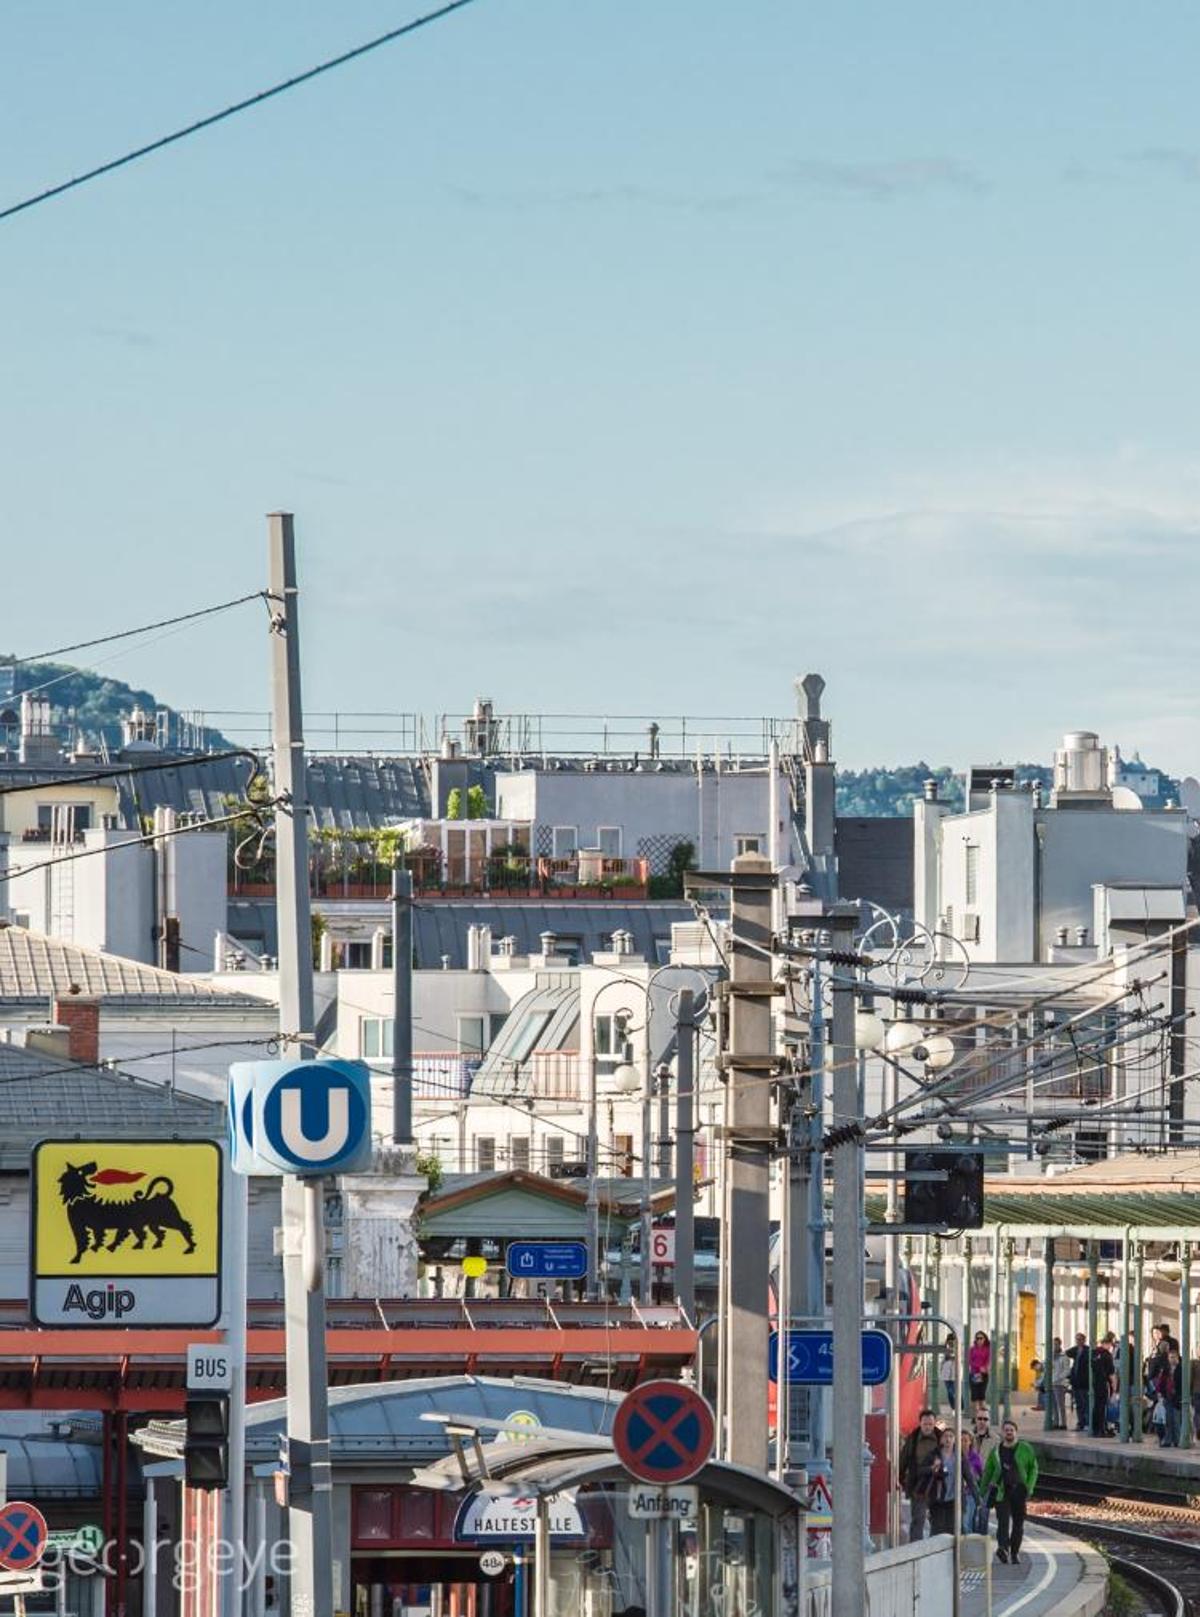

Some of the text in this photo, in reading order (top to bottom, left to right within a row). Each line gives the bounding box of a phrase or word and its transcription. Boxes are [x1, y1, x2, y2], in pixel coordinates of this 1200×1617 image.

[280, 1087, 349, 1162] U
[654, 1234, 667, 1257] 6
[62, 1284, 136, 1320] Agip
[536, 1282, 547, 1299] 5
[194, 1359, 227, 1378] BUS
[634, 1493, 690, 1518] Anfang
[474, 1518, 572, 1532] HALTESTLLE
